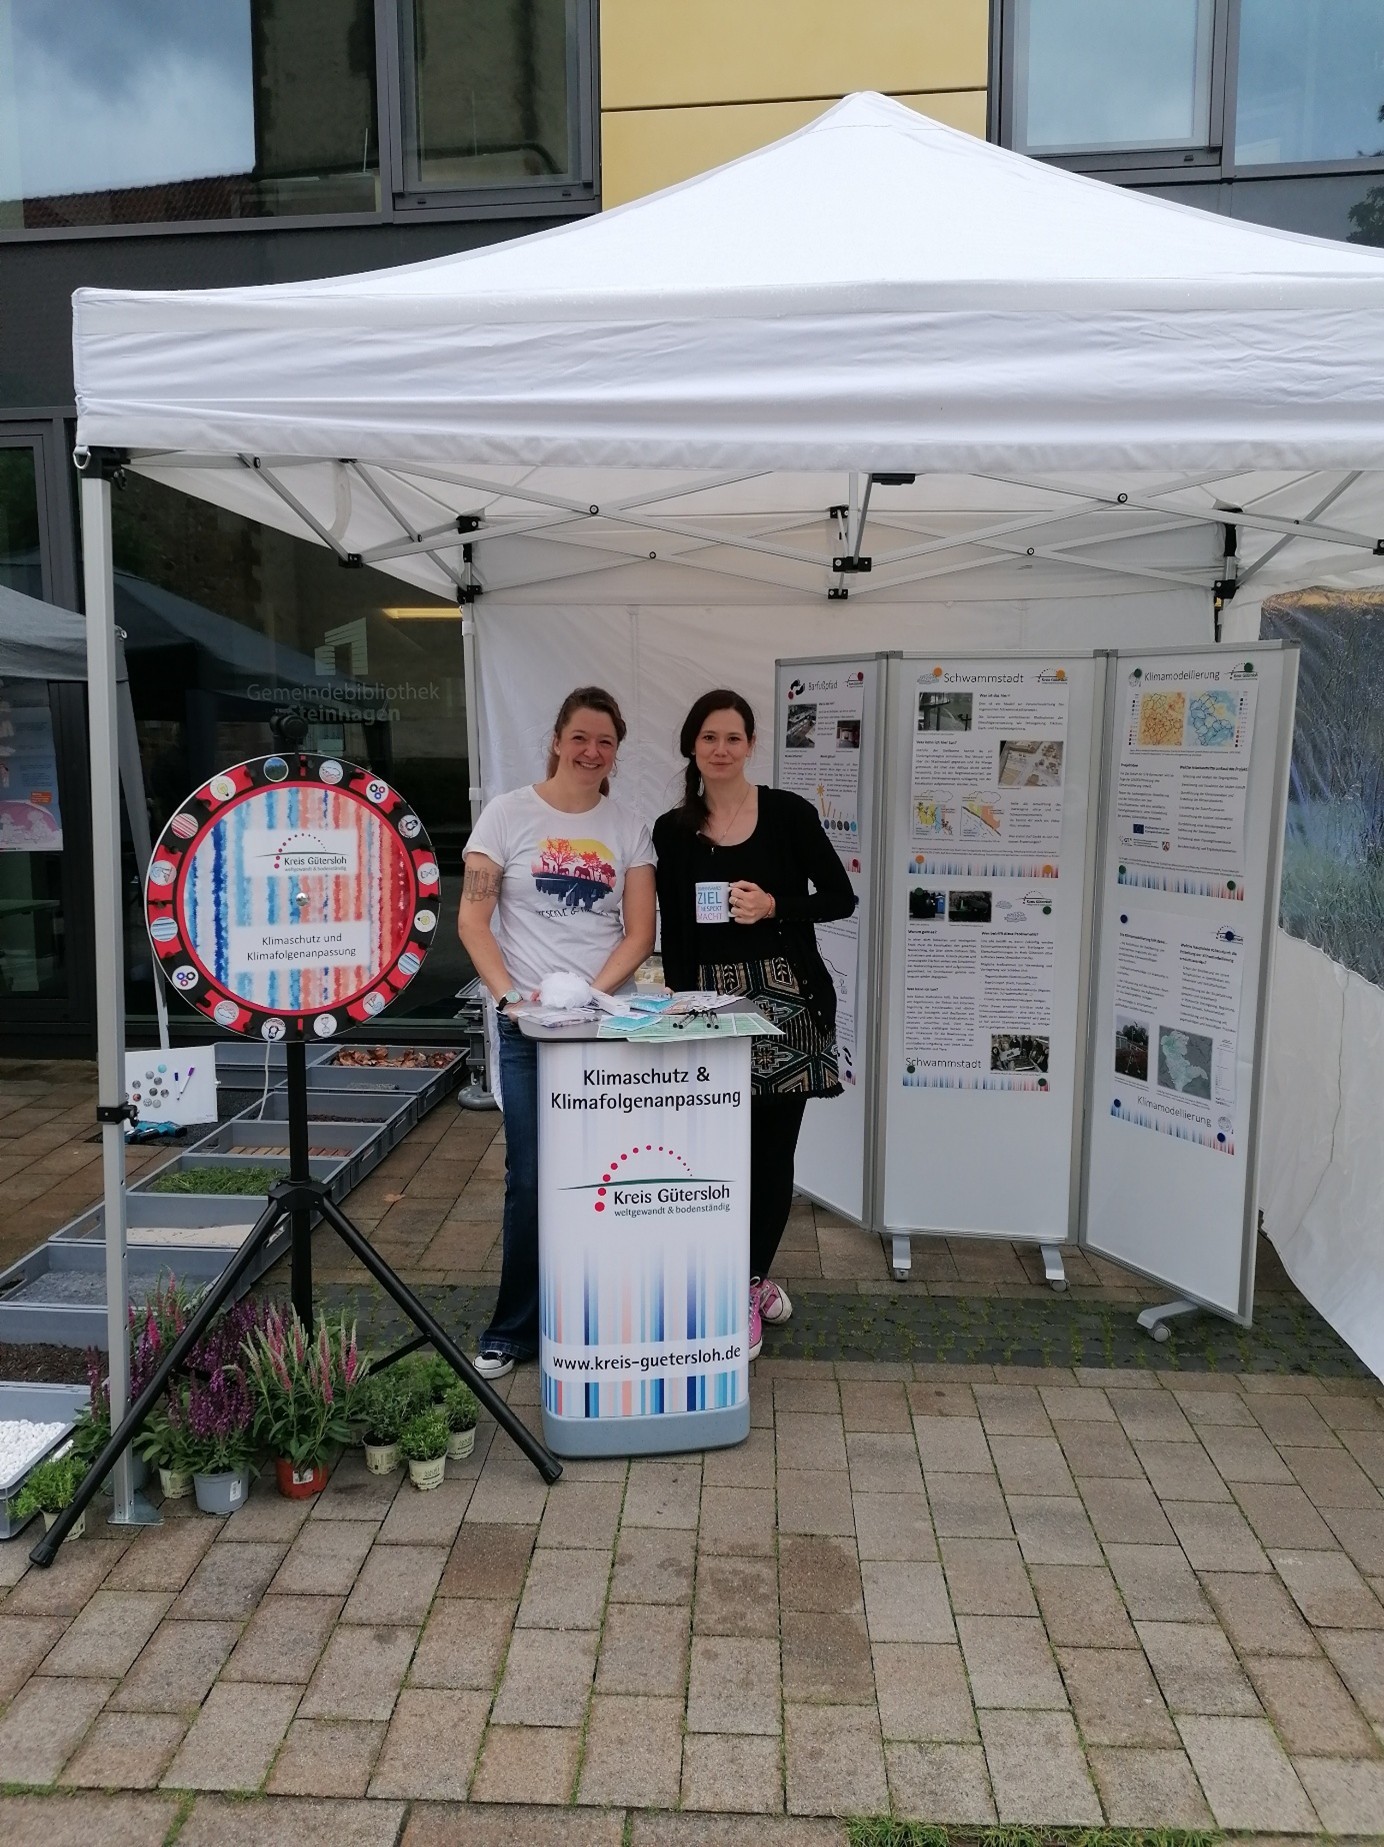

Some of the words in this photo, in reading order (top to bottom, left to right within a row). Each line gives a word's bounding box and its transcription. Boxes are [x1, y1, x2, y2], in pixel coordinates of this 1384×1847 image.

[943, 672, 1024, 684] Schwammstadt
[1144, 670, 1220, 681] Klimamodellierung
[247, 682, 440, 701] Gemeindebibliothek
[284, 857, 305, 866] Kreis
[307, 856, 347, 866] Gütersloh
[697, 892, 722, 904] ZIEL
[262, 934, 321, 946] Klimaschutz
[324, 933, 342, 943] und
[247, 948, 356, 961] Klimafolgenanpassung
[905, 1057, 982, 1069] Schwammstadt
[583, 1068, 689, 1086] Klimaschutz
[696, 1066, 711, 1082] &
[551, 1091, 742, 1113] Klimafolgenanpassung
[1137, 1096, 1212, 1127] Klimamodellierung
[614, 1190, 652, 1205] Kreis
[657, 1185, 730, 1203] Gütersloh
[614, 1207, 666, 1218] weltgewandt
[667, 1206, 674, 1214] &
[675, 1203, 731, 1213] bodenständig
[553, 1345, 741, 1372] www.kreis-guetersloh.de
